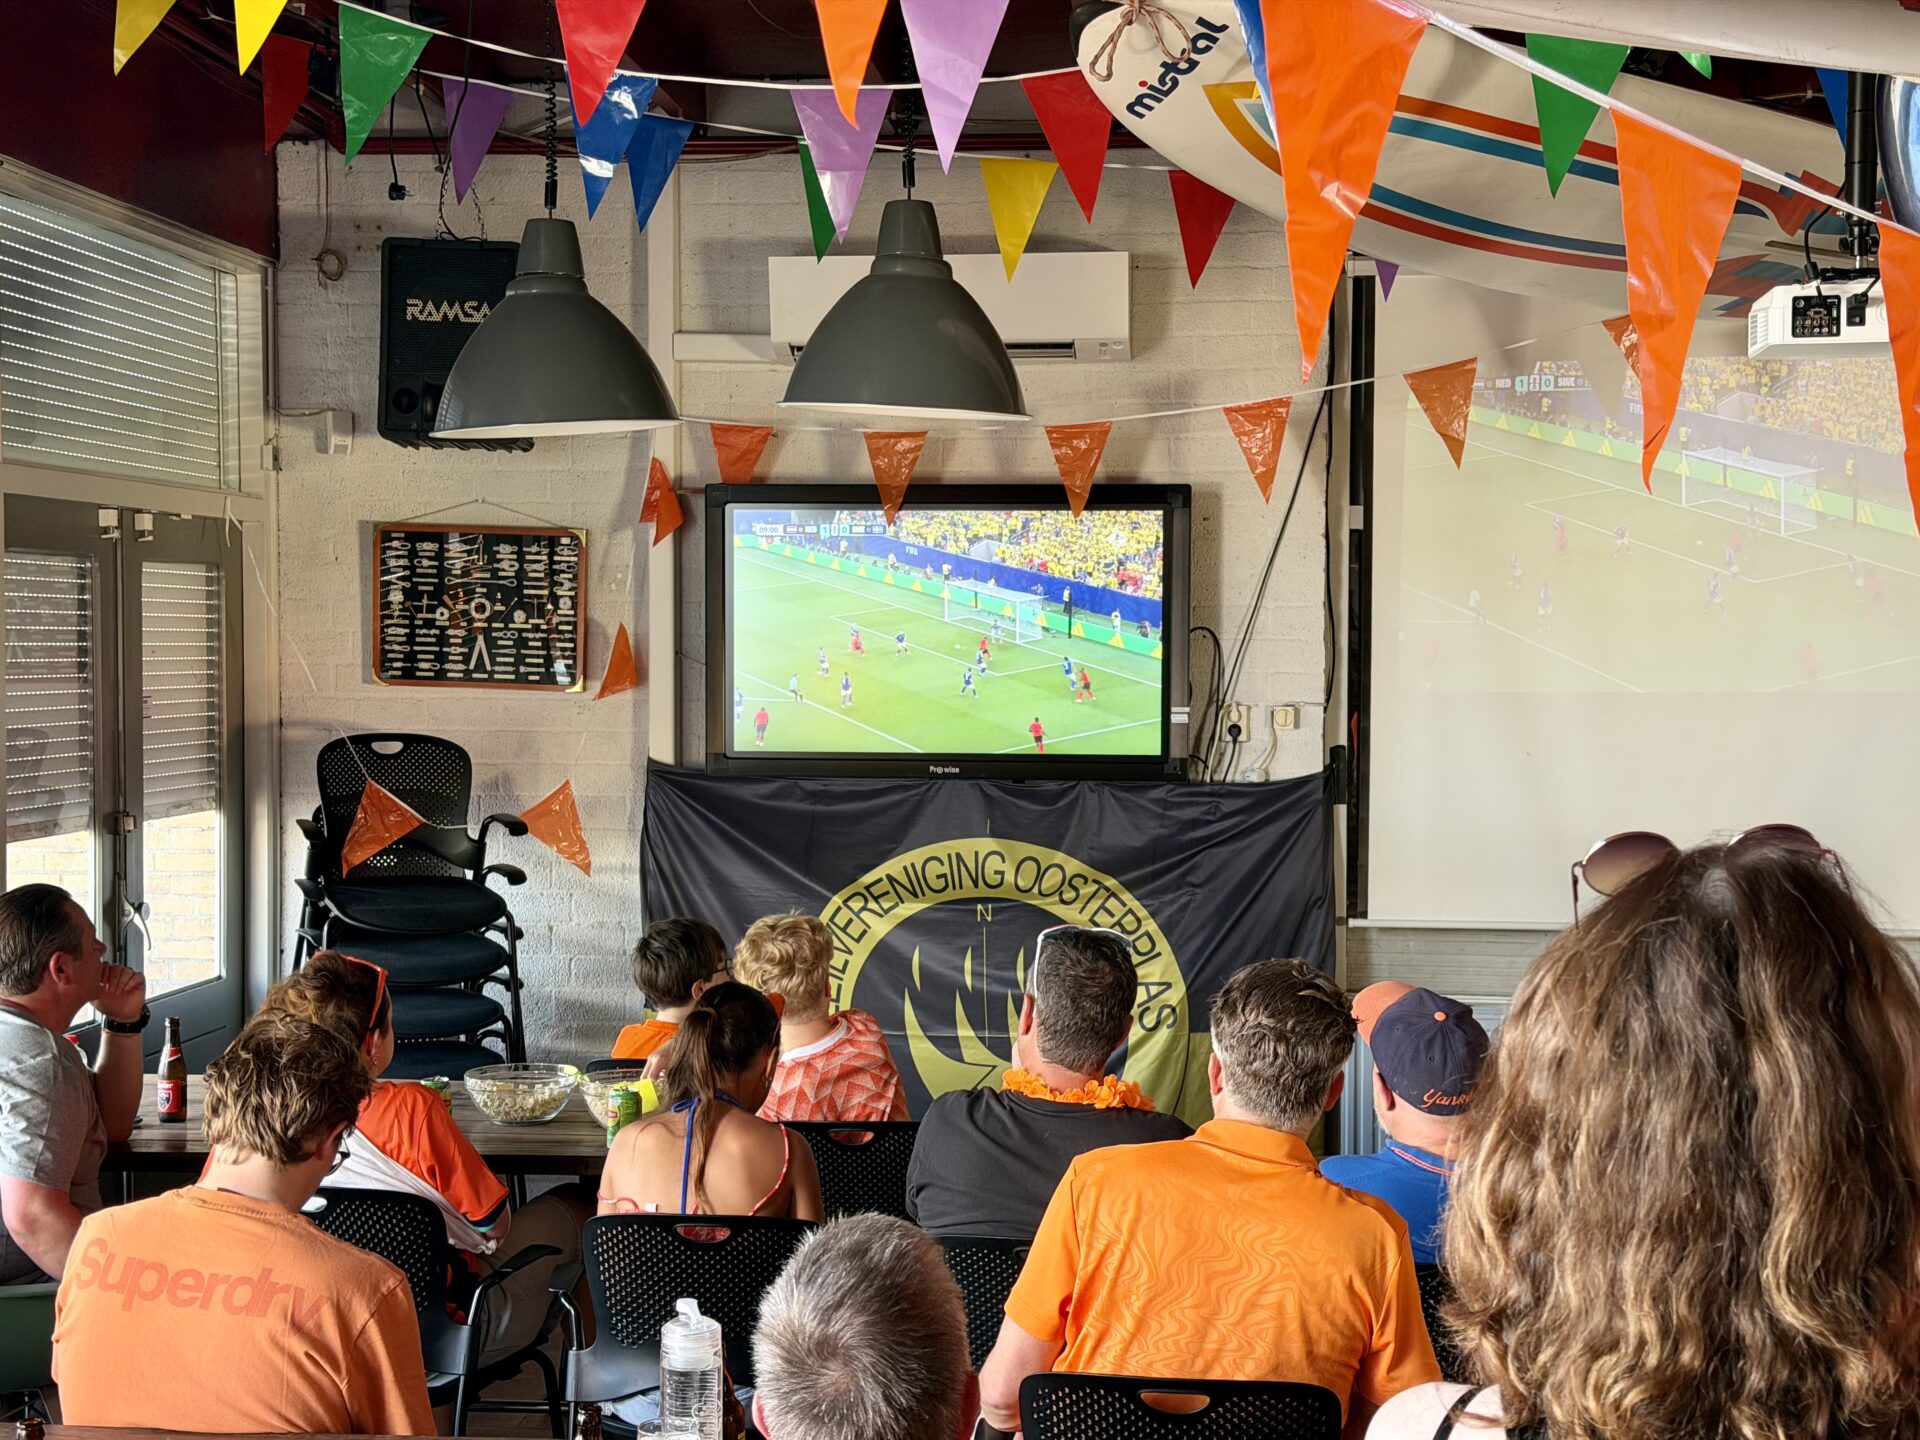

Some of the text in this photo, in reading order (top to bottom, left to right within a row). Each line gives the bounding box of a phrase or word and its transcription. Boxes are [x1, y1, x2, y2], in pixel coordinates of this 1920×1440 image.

[1126, 16, 1230, 119] mistral
[929, 765, 960, 774] Prowise
[976, 903, 993, 923] N
[76, 1238, 328, 1338] Superdry
